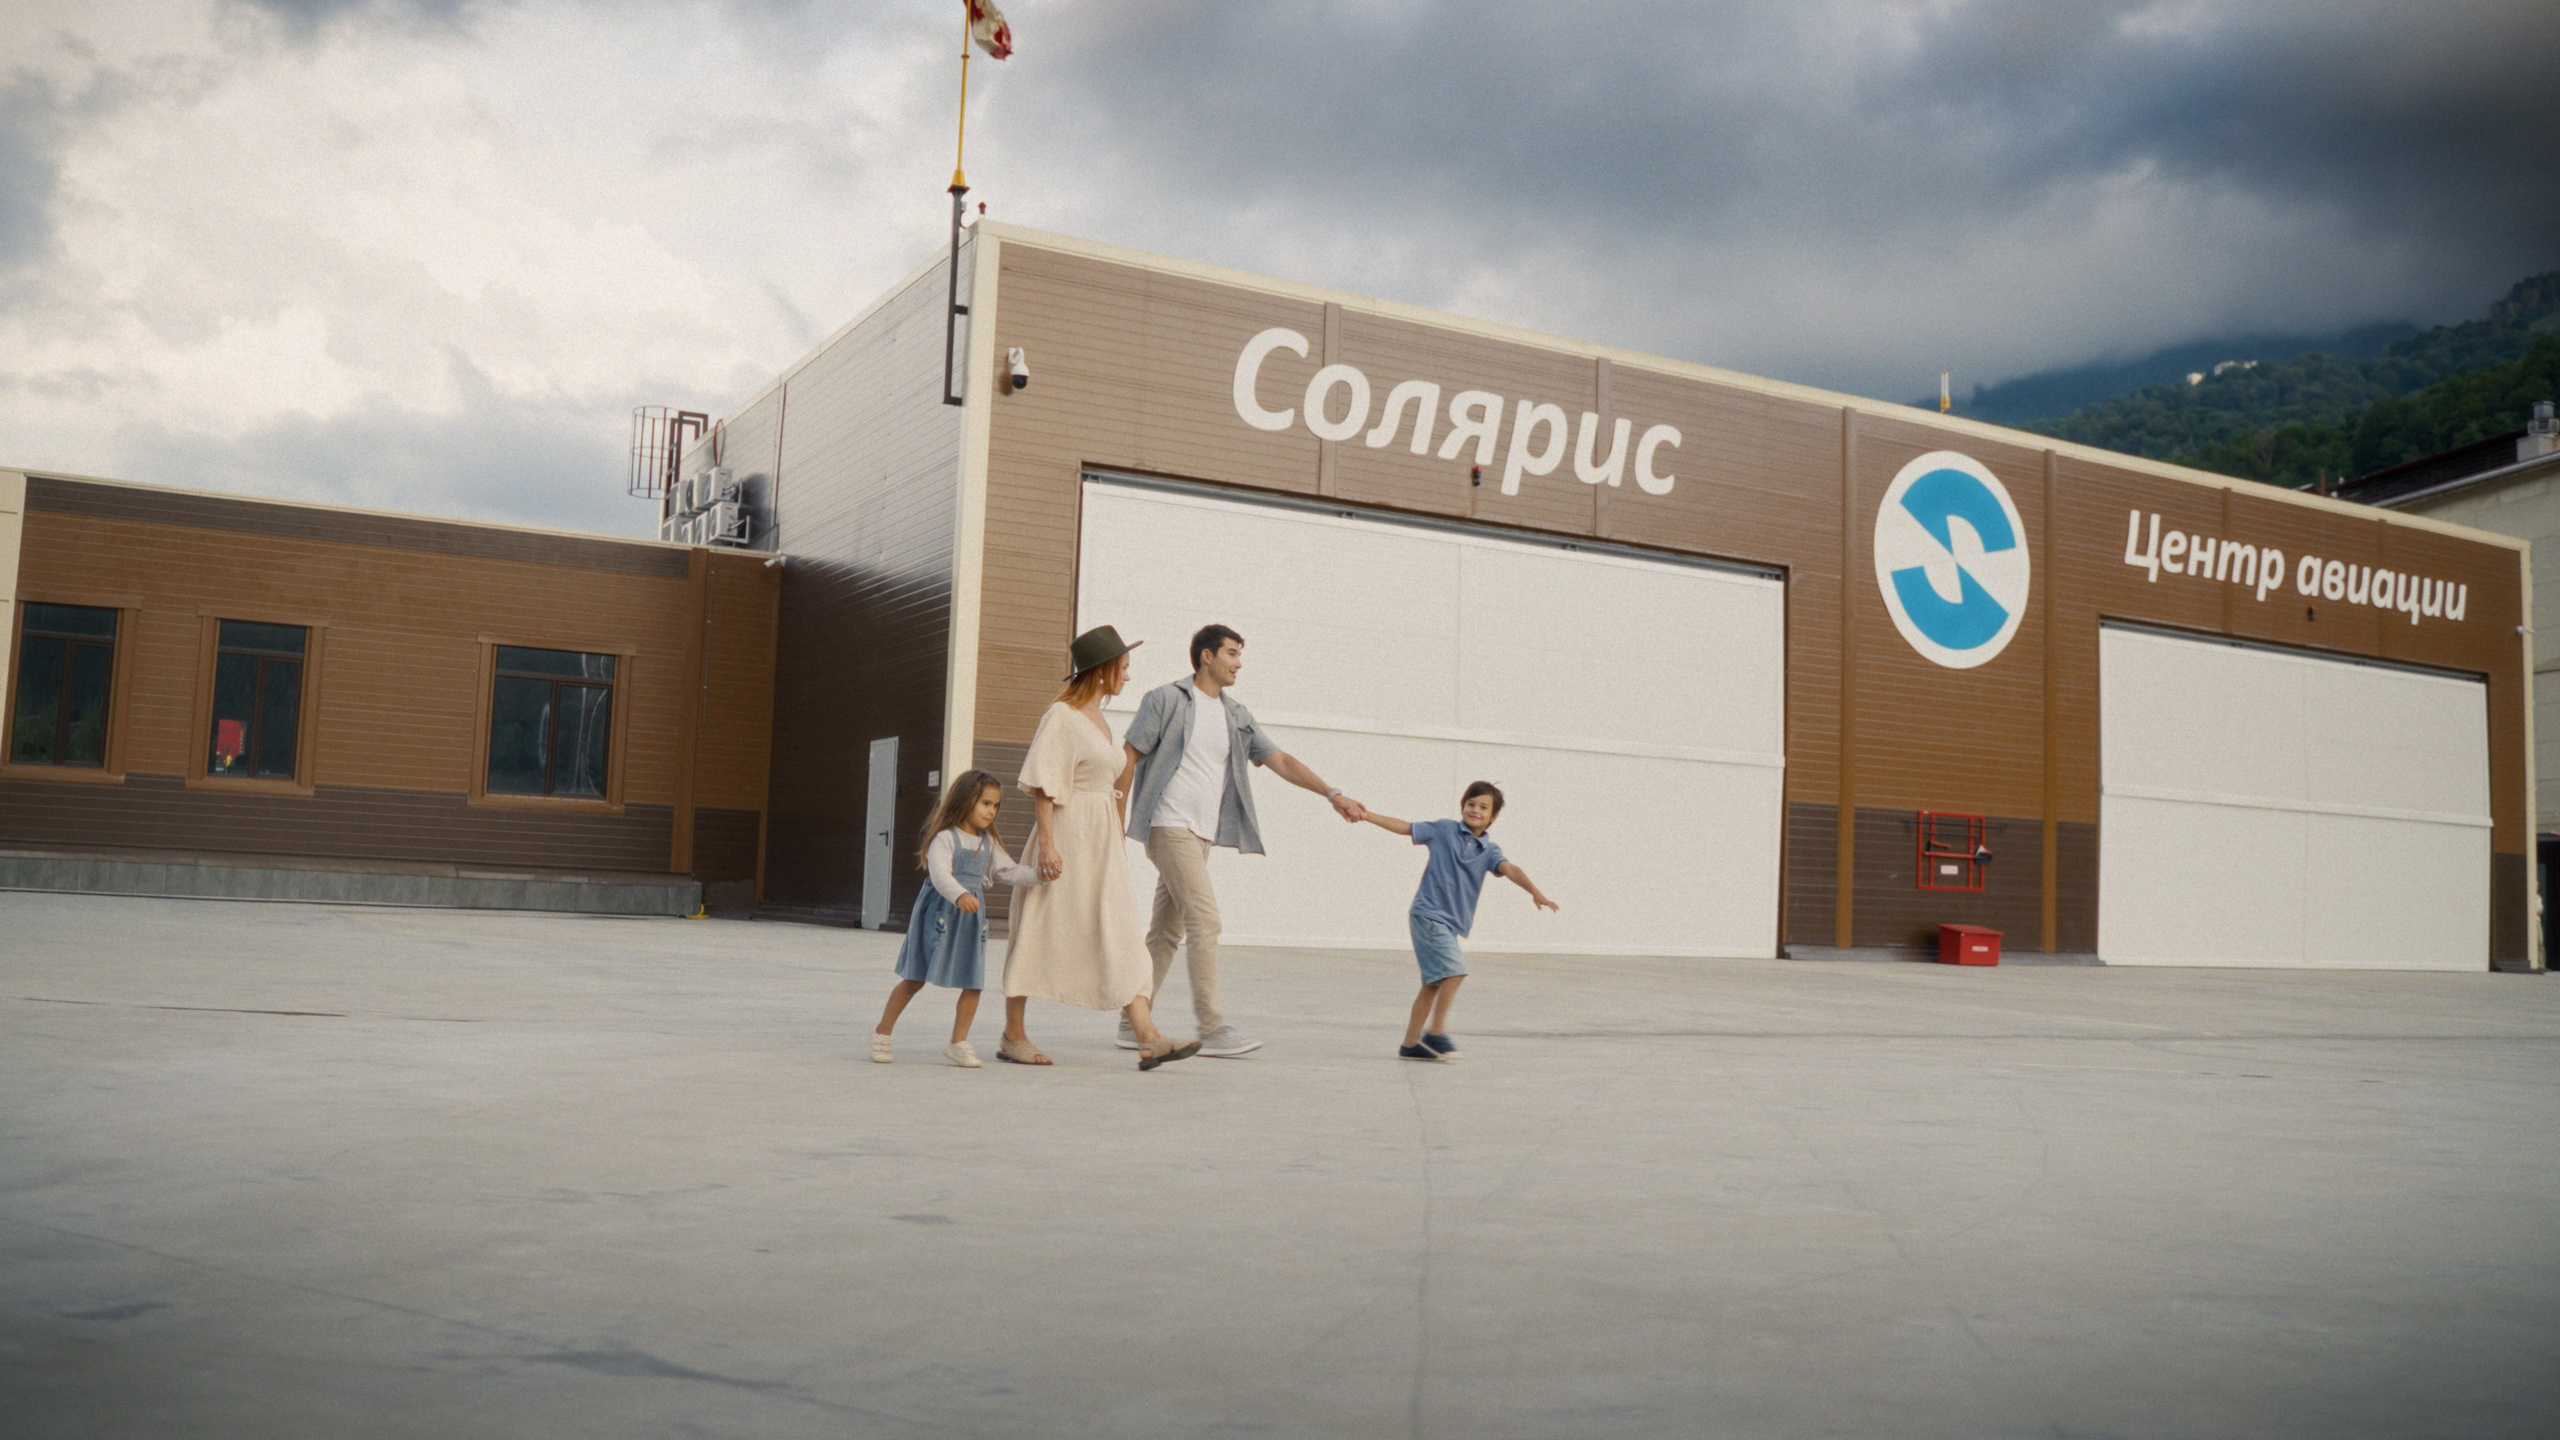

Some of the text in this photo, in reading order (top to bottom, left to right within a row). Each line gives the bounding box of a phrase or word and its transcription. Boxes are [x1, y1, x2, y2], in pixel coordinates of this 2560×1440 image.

[1232, 327, 1682, 496] Солярис
[2124, 509, 2467, 625] Центр авиации
